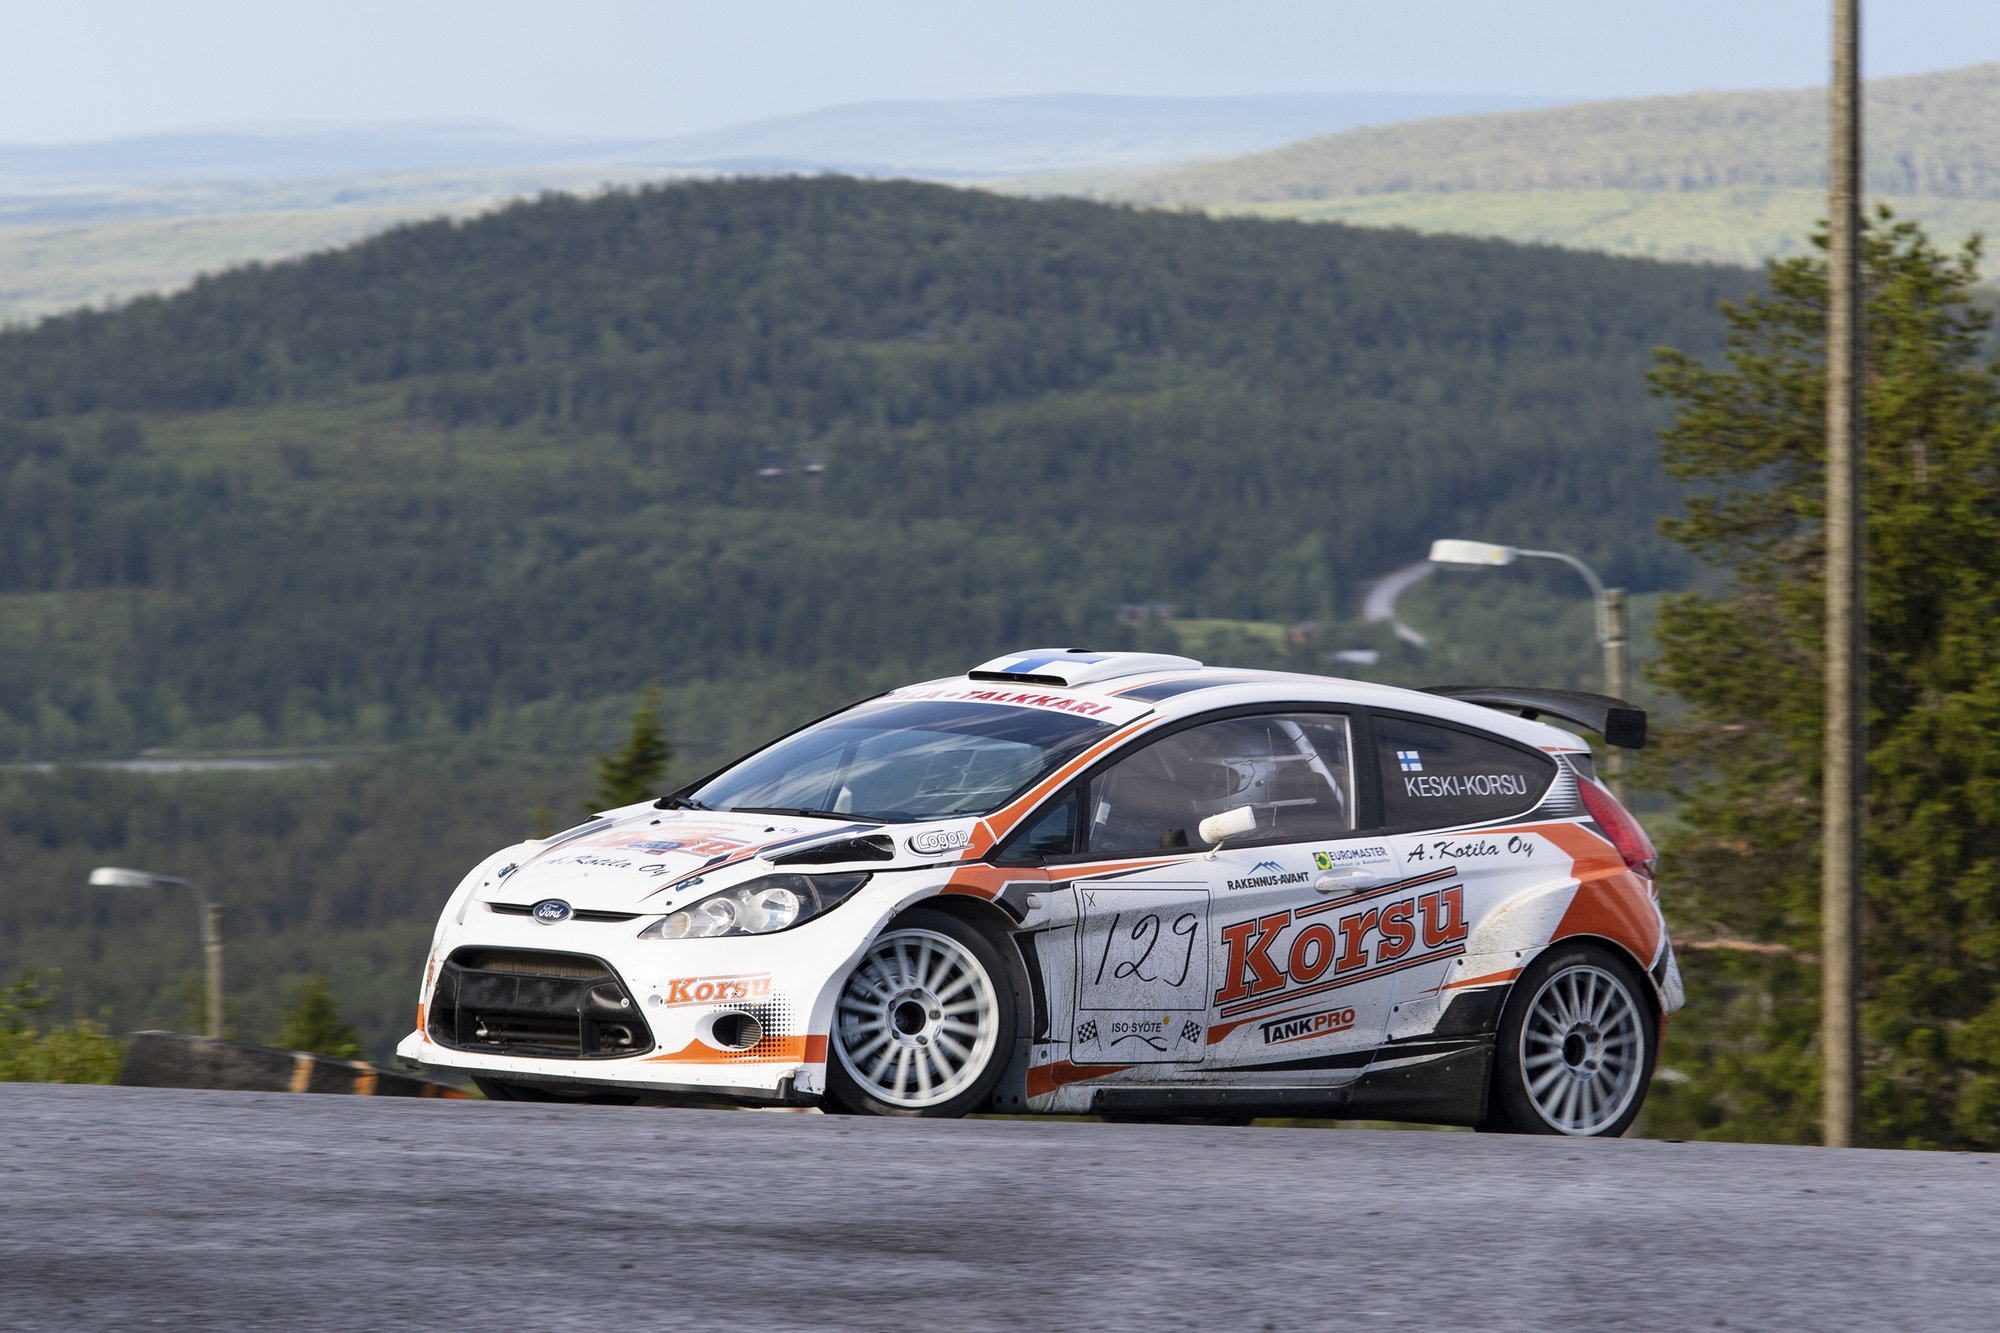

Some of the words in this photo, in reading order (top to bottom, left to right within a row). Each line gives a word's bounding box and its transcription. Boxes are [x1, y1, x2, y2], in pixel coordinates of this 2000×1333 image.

[958, 690, 1112, 715] TALKKARI
[1404, 774, 1527, 797] KESKI-KORSU
[1328, 846, 1388, 861] EUROMASTER
[1508, 836, 1535, 858] Oy
[638, 864, 671, 877] Oy
[1227, 871, 1309, 891] RAKENNUS-AVANT
[539, 903, 563, 918] Ford
[1095, 912, 1199, 987] 129
[1213, 884, 1469, 1007] Korsu
[664, 977, 772, 1004] Korsu
